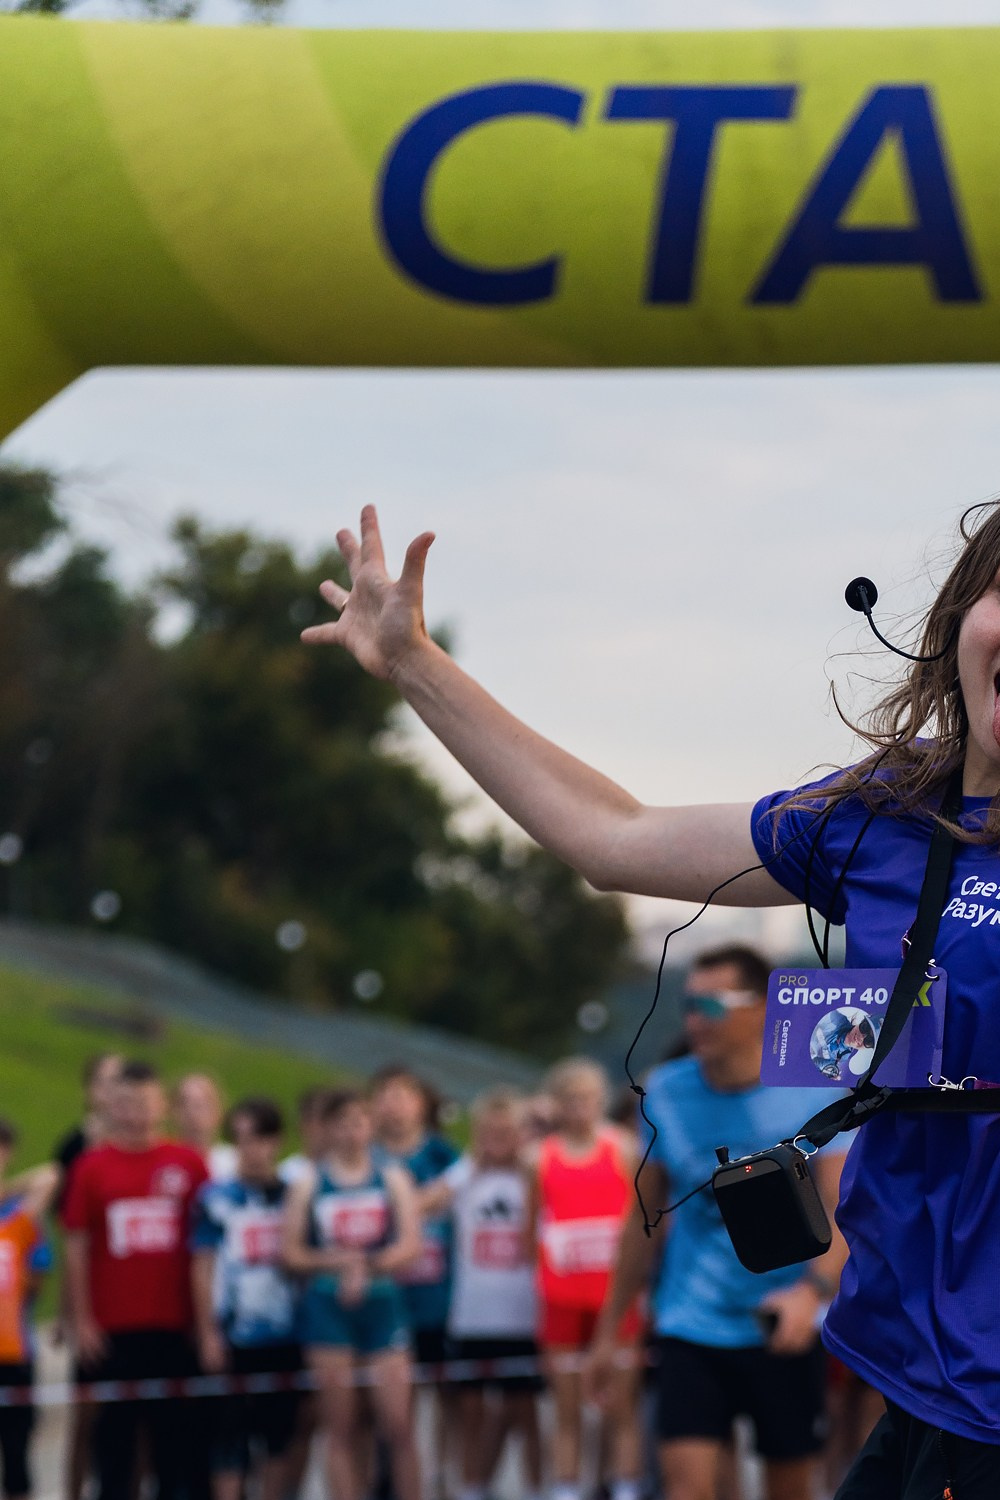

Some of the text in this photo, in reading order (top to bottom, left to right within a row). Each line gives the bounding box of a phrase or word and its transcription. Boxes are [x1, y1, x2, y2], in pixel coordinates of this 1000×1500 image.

[778, 975, 808, 987] PRO
[777, 987, 889, 1005] СПОРТ 40
[779, 1019, 791, 1067] Светлана
